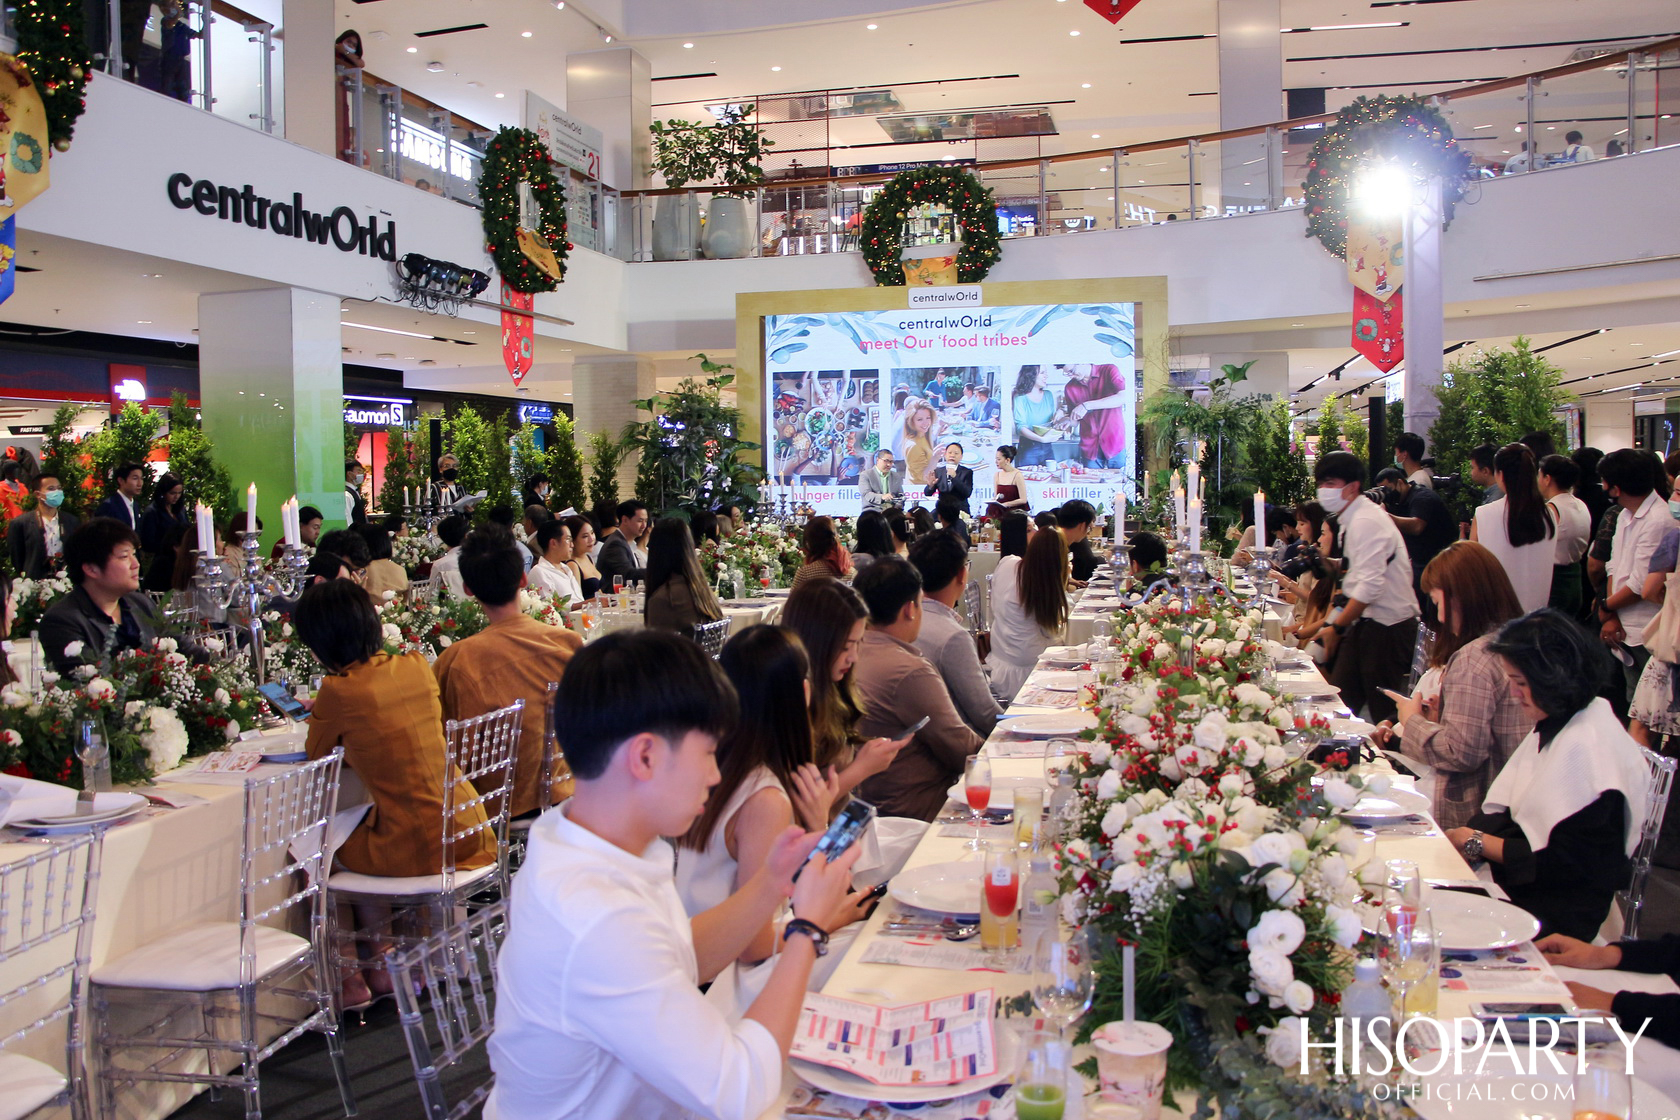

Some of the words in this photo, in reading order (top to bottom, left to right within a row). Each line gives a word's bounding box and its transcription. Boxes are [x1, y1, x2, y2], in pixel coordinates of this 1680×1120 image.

[588, 152, 600, 180] 21
[167, 172, 397, 262] centralwOrld
[913, 291, 978, 303] centralwOrld
[899, 315, 992, 330] centralwOrld
[860, 337, 898, 350] meet
[904, 335, 933, 349] Our
[838, 488, 860, 500] fille
[1042, 487, 1068, 498] skill
[1071, 487, 1102, 499] filler
